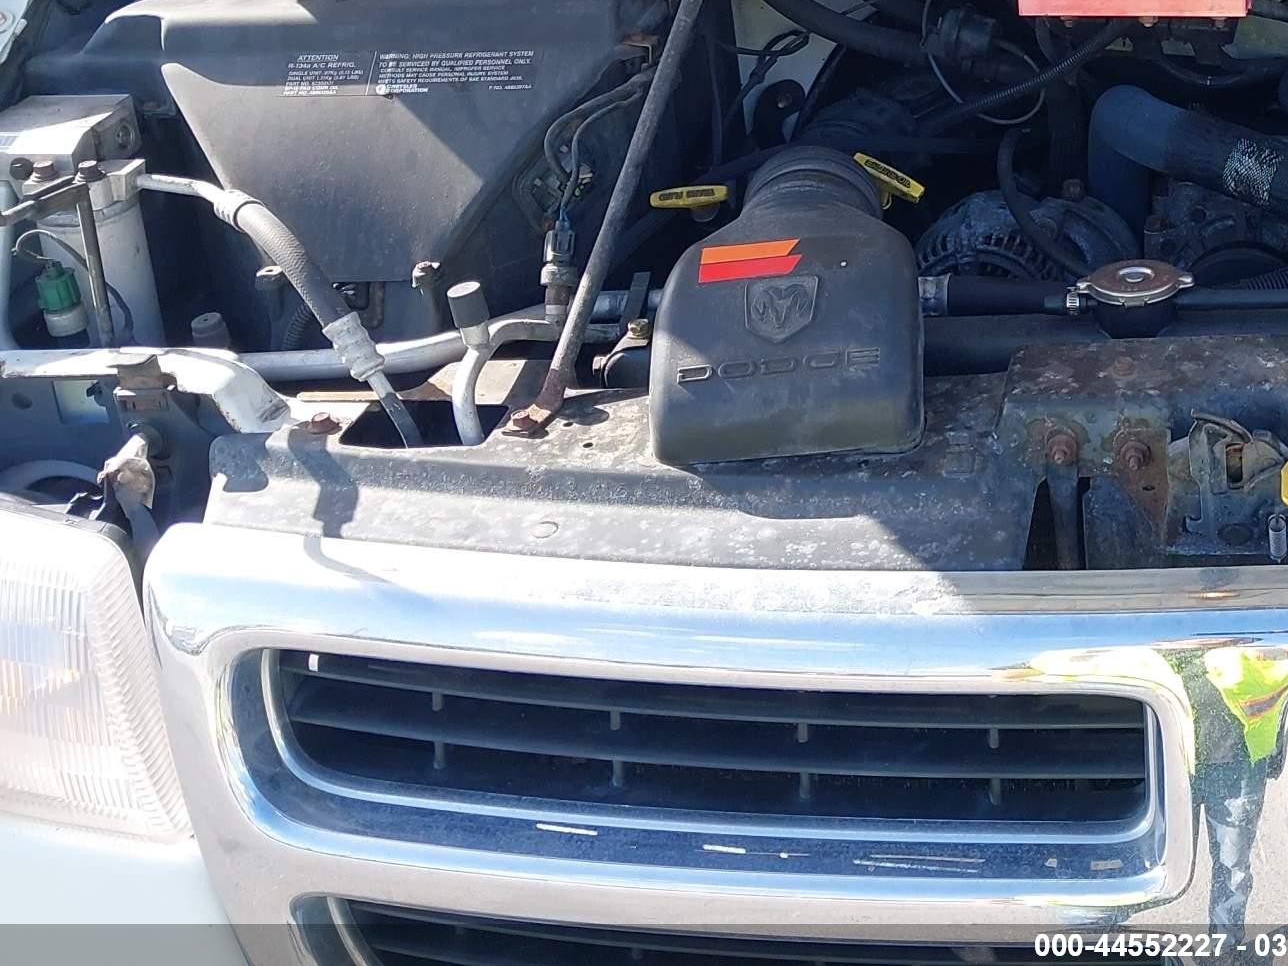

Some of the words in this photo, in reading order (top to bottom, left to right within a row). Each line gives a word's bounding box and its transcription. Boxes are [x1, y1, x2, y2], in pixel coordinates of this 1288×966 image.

[297, 54, 339, 62] ATTENTION
[399, 60, 430, 68] SERVICED
[677, 347, 881, 384] DODGE
